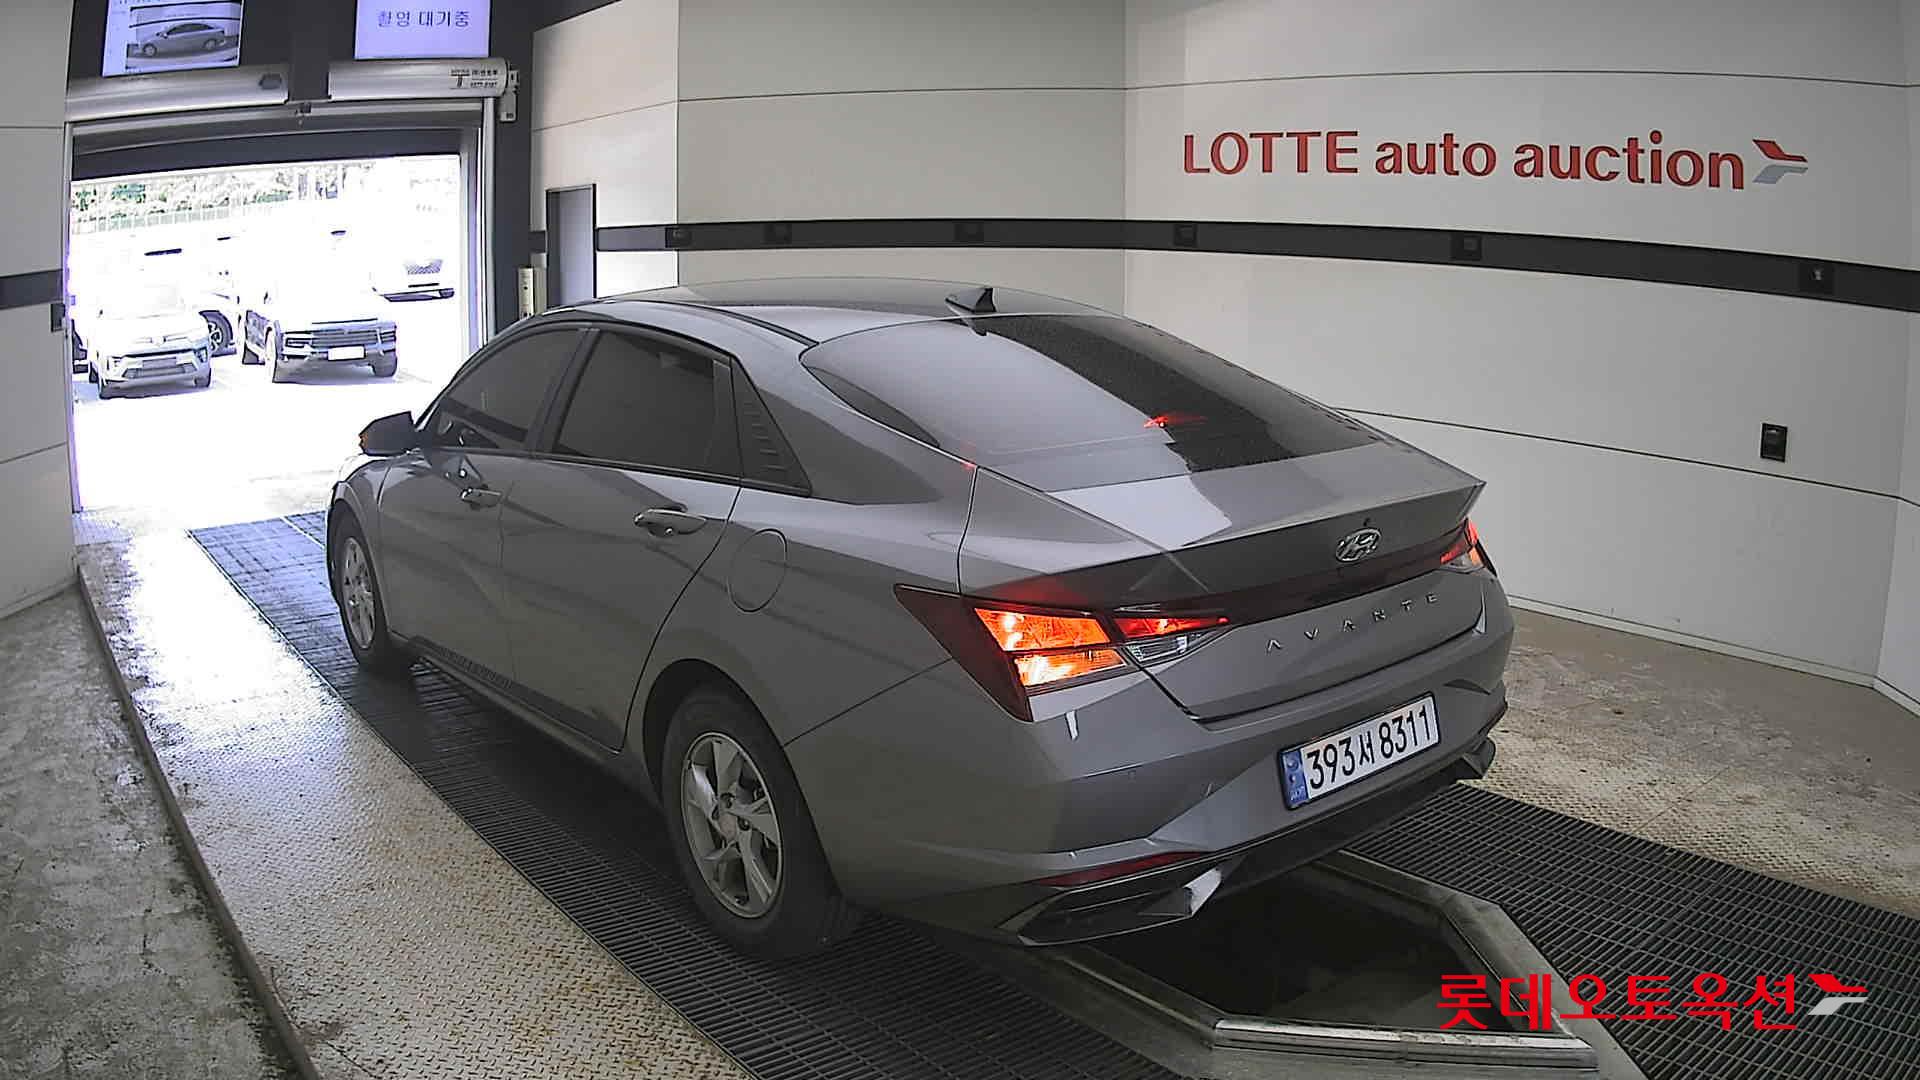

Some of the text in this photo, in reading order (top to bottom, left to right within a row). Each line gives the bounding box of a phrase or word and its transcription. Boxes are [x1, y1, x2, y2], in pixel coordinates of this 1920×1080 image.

[418, 11, 470, 27] 대기중
[1184, 130, 1744, 190] LOTTE auto auction
[1267, 592, 1437, 653] AVANTE
